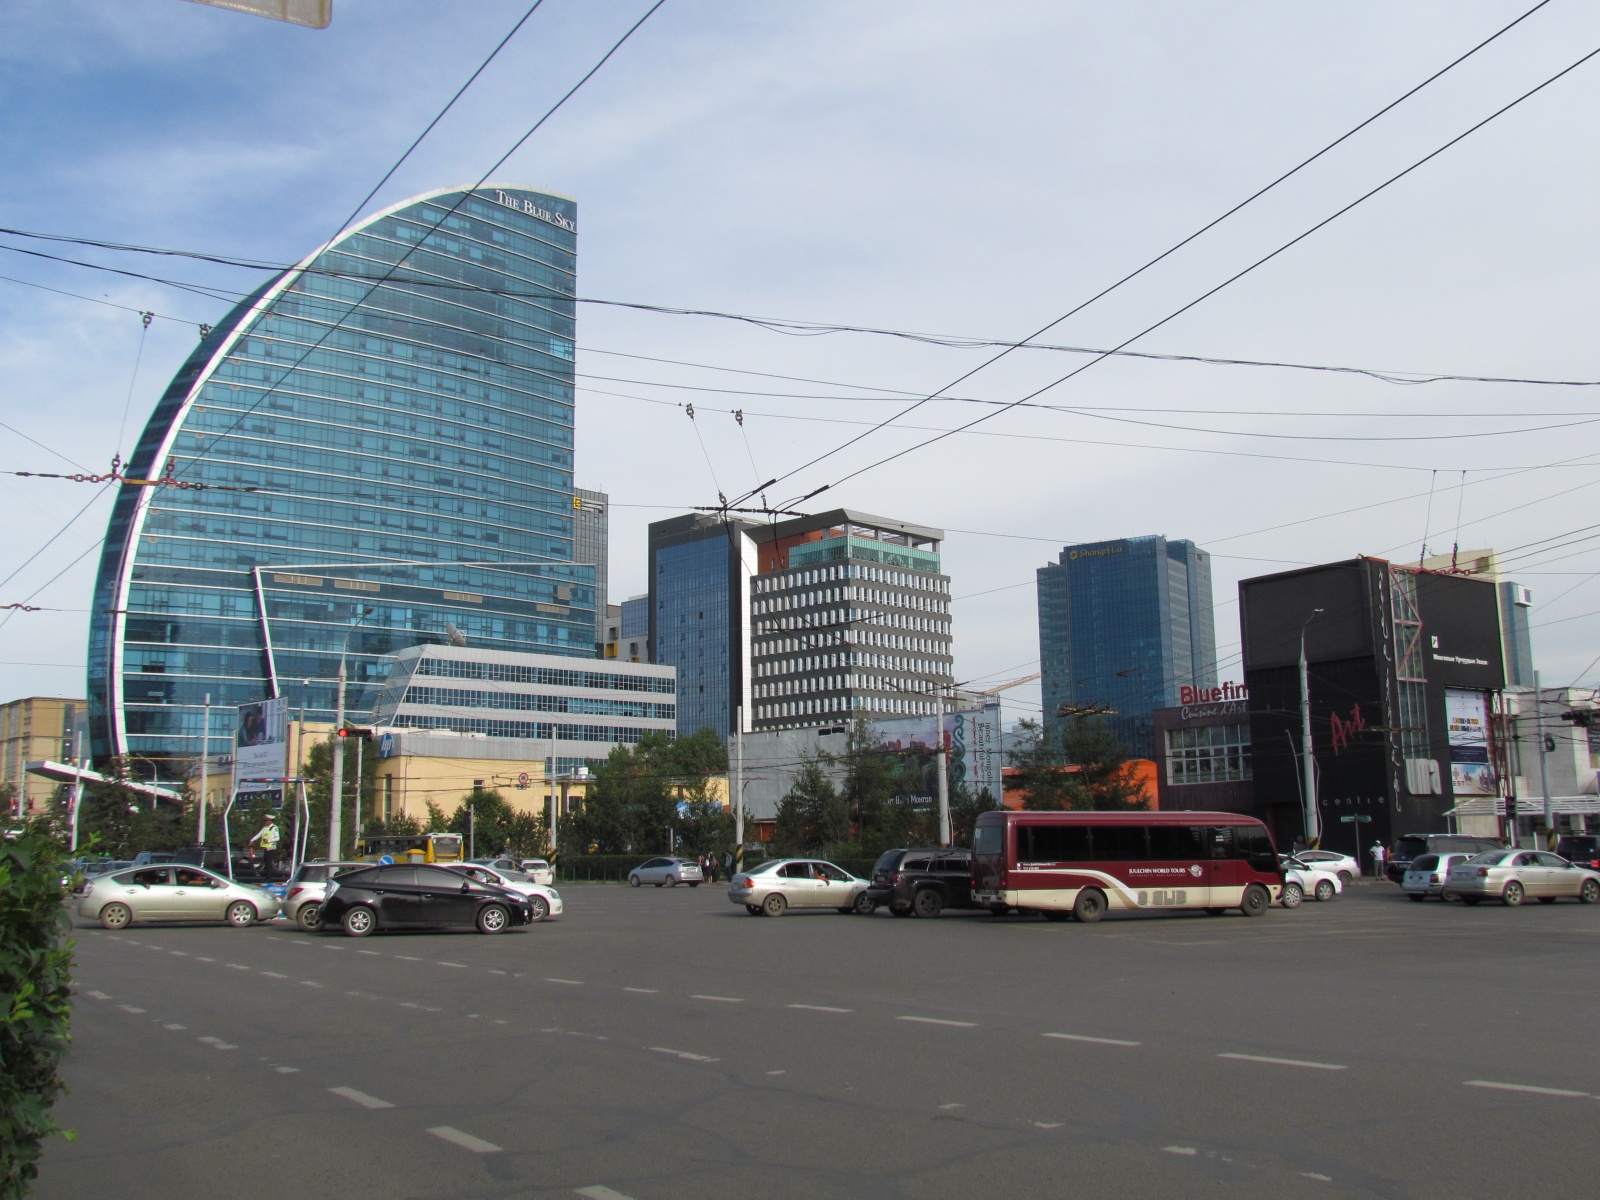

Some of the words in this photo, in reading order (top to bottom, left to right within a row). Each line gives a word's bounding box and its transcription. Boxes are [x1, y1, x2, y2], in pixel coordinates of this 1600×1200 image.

[1180, 681, 1248, 705] Bluefin
[1181, 706, 1217, 720] Cuisine
[1330, 703, 1365, 756] Art
[381, 733, 394, 758] hp
[985, 748, 993, 786] Mongolia
